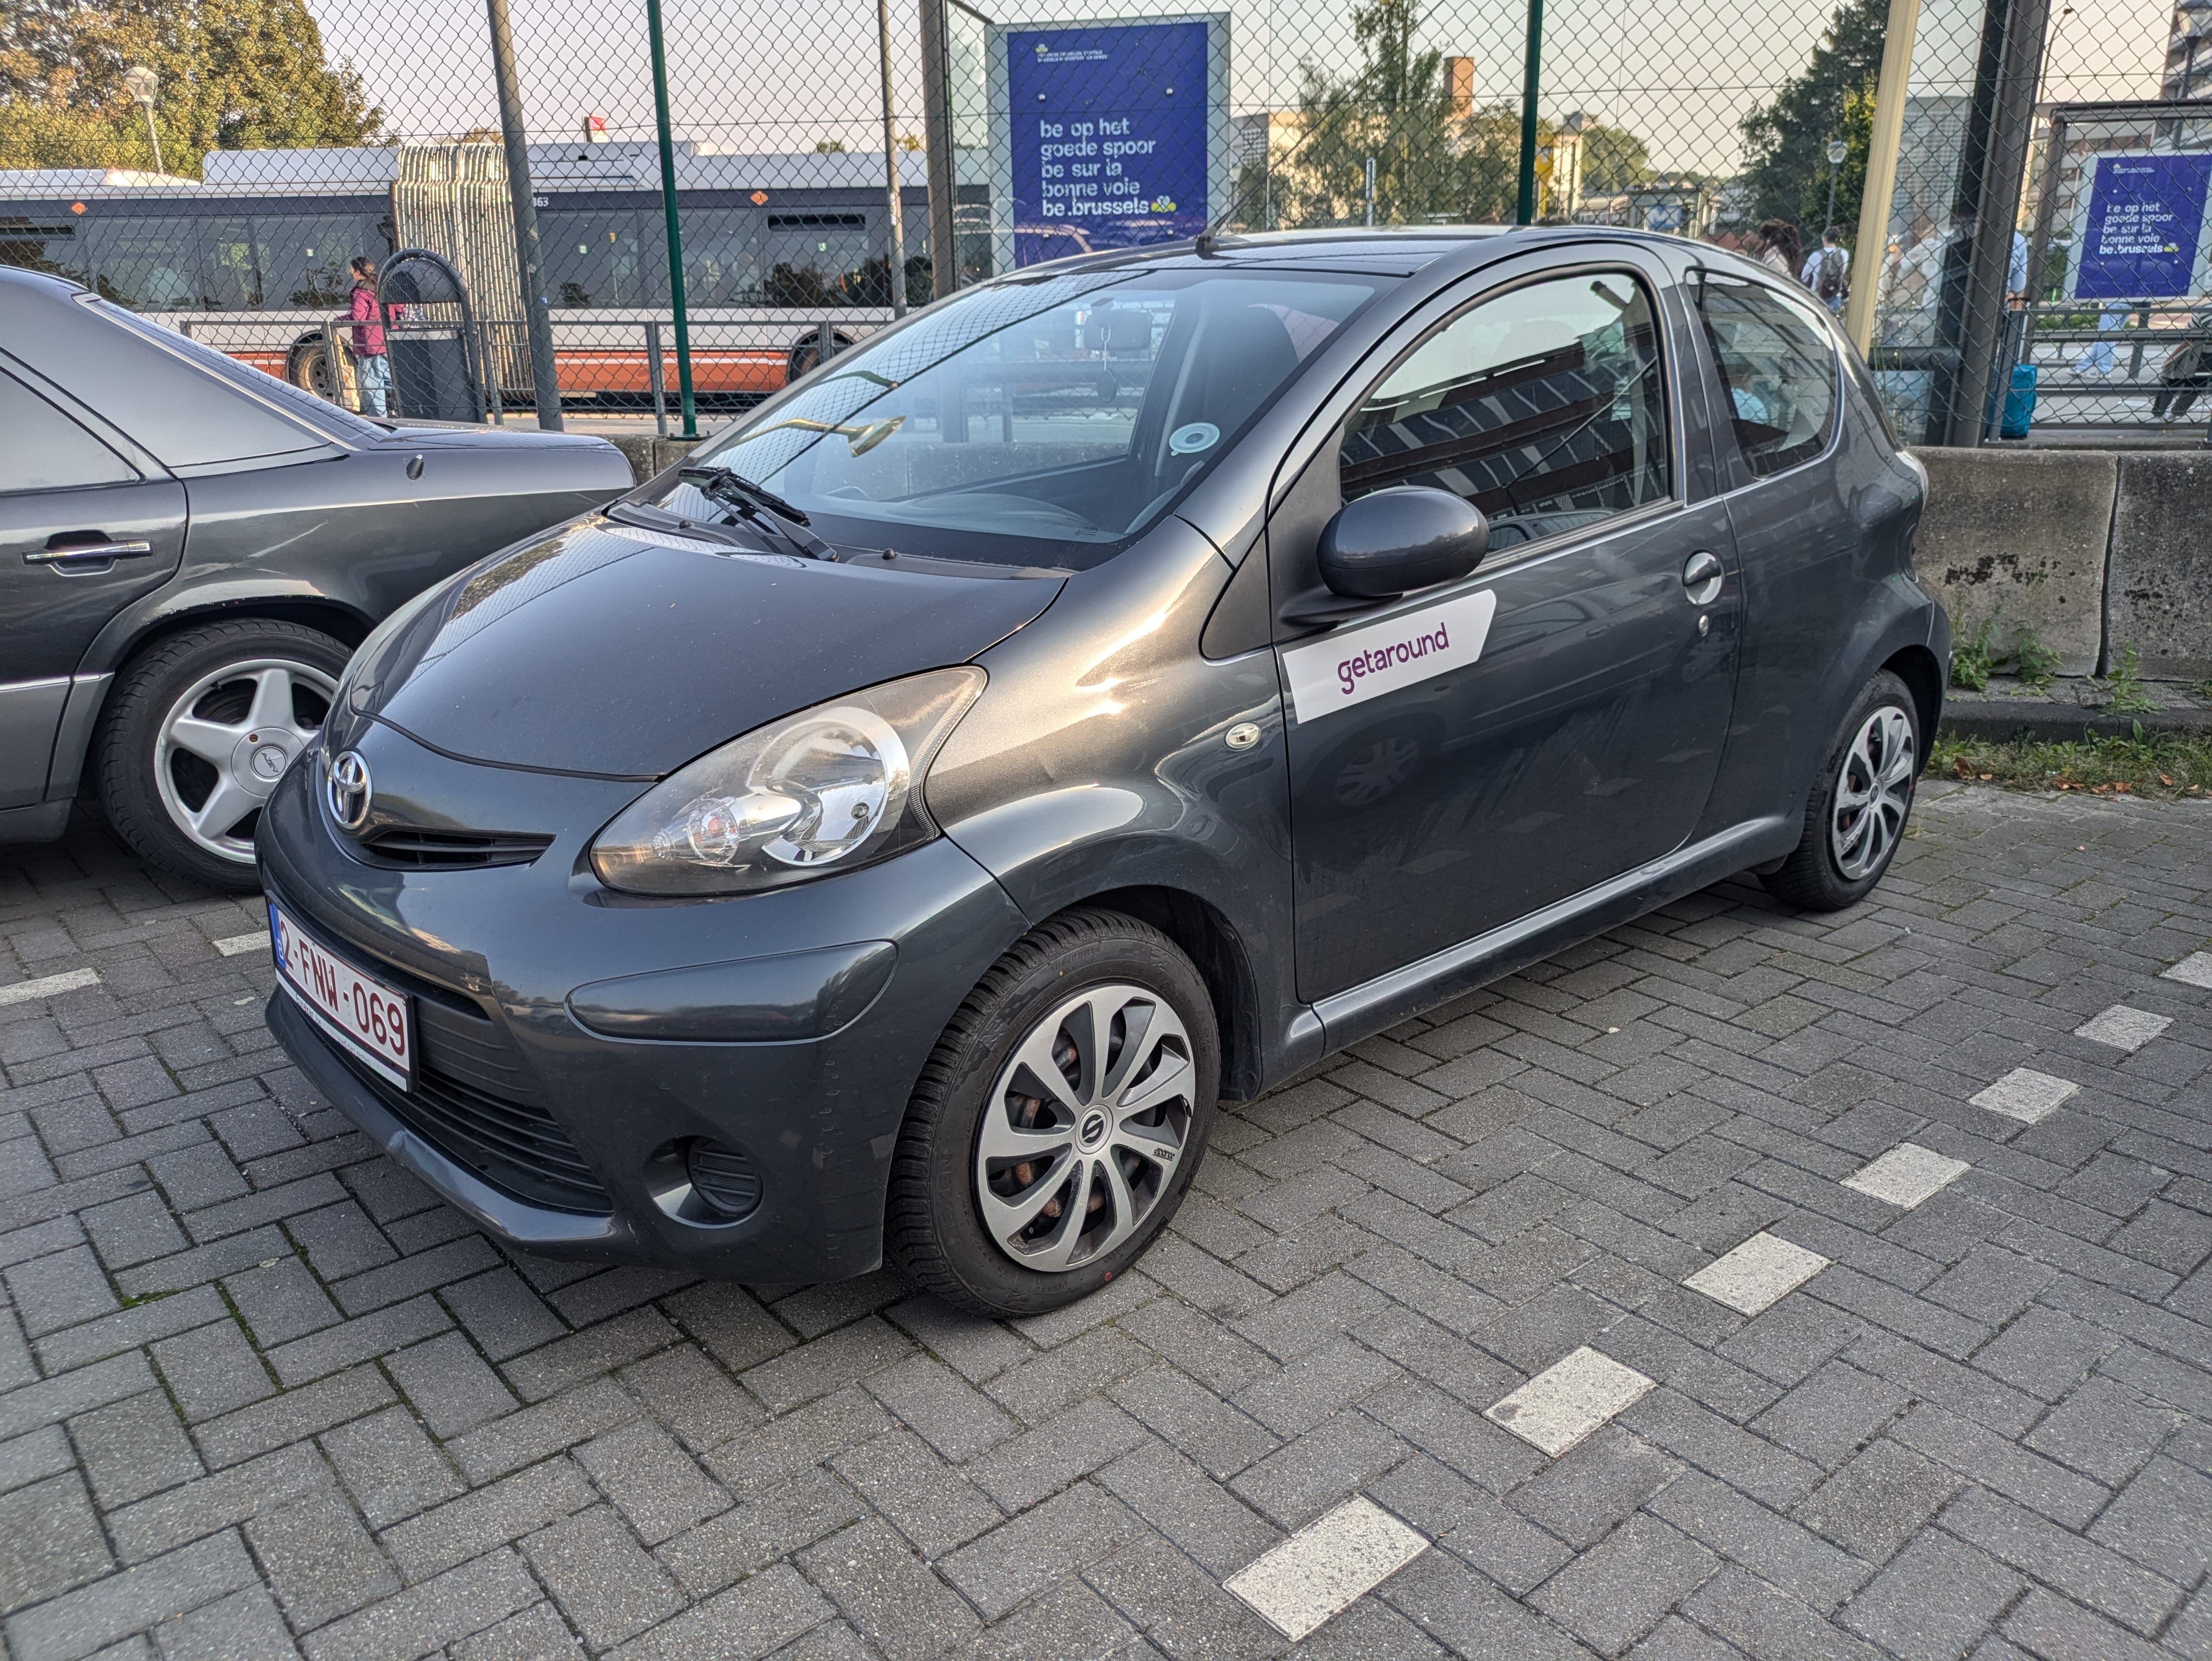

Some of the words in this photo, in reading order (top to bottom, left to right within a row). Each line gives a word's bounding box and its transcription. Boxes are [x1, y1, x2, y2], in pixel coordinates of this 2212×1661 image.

[1040, 120, 1063, 138] be
[1071, 122, 1094, 141] op
[1099, 118, 1130, 136] het
[1040, 140, 1098, 161] goede
[1103, 140, 1156, 159] spoor
[1041, 161, 1064, 178] be
[1072, 163, 1101, 177] sur
[1106, 158, 1122, 177] la
[1042, 180, 1098, 198] bonne
[1103, 177, 1140, 196] voie
[1042, 196, 1149, 217] be.brussels
[2124, 204, 2139, 215] op
[2141, 202, 2160, 212] het
[2103, 224, 2117, 234] be
[2121, 225, 2139, 233] sur
[2141, 223, 2152, 233] la
[2104, 214, 2140, 225] goede
[2142, 214, 2174, 223] spoor
[2099, 243, 2163, 254] be.brussels
[2101, 234, 2135, 244] bonne
[2138, 233, 2160, 243] voie
[1337, 622, 1449, 695] getaround
[277, 938, 284, 961] B
[280, 920, 405, 1056] 2-FNW-069
